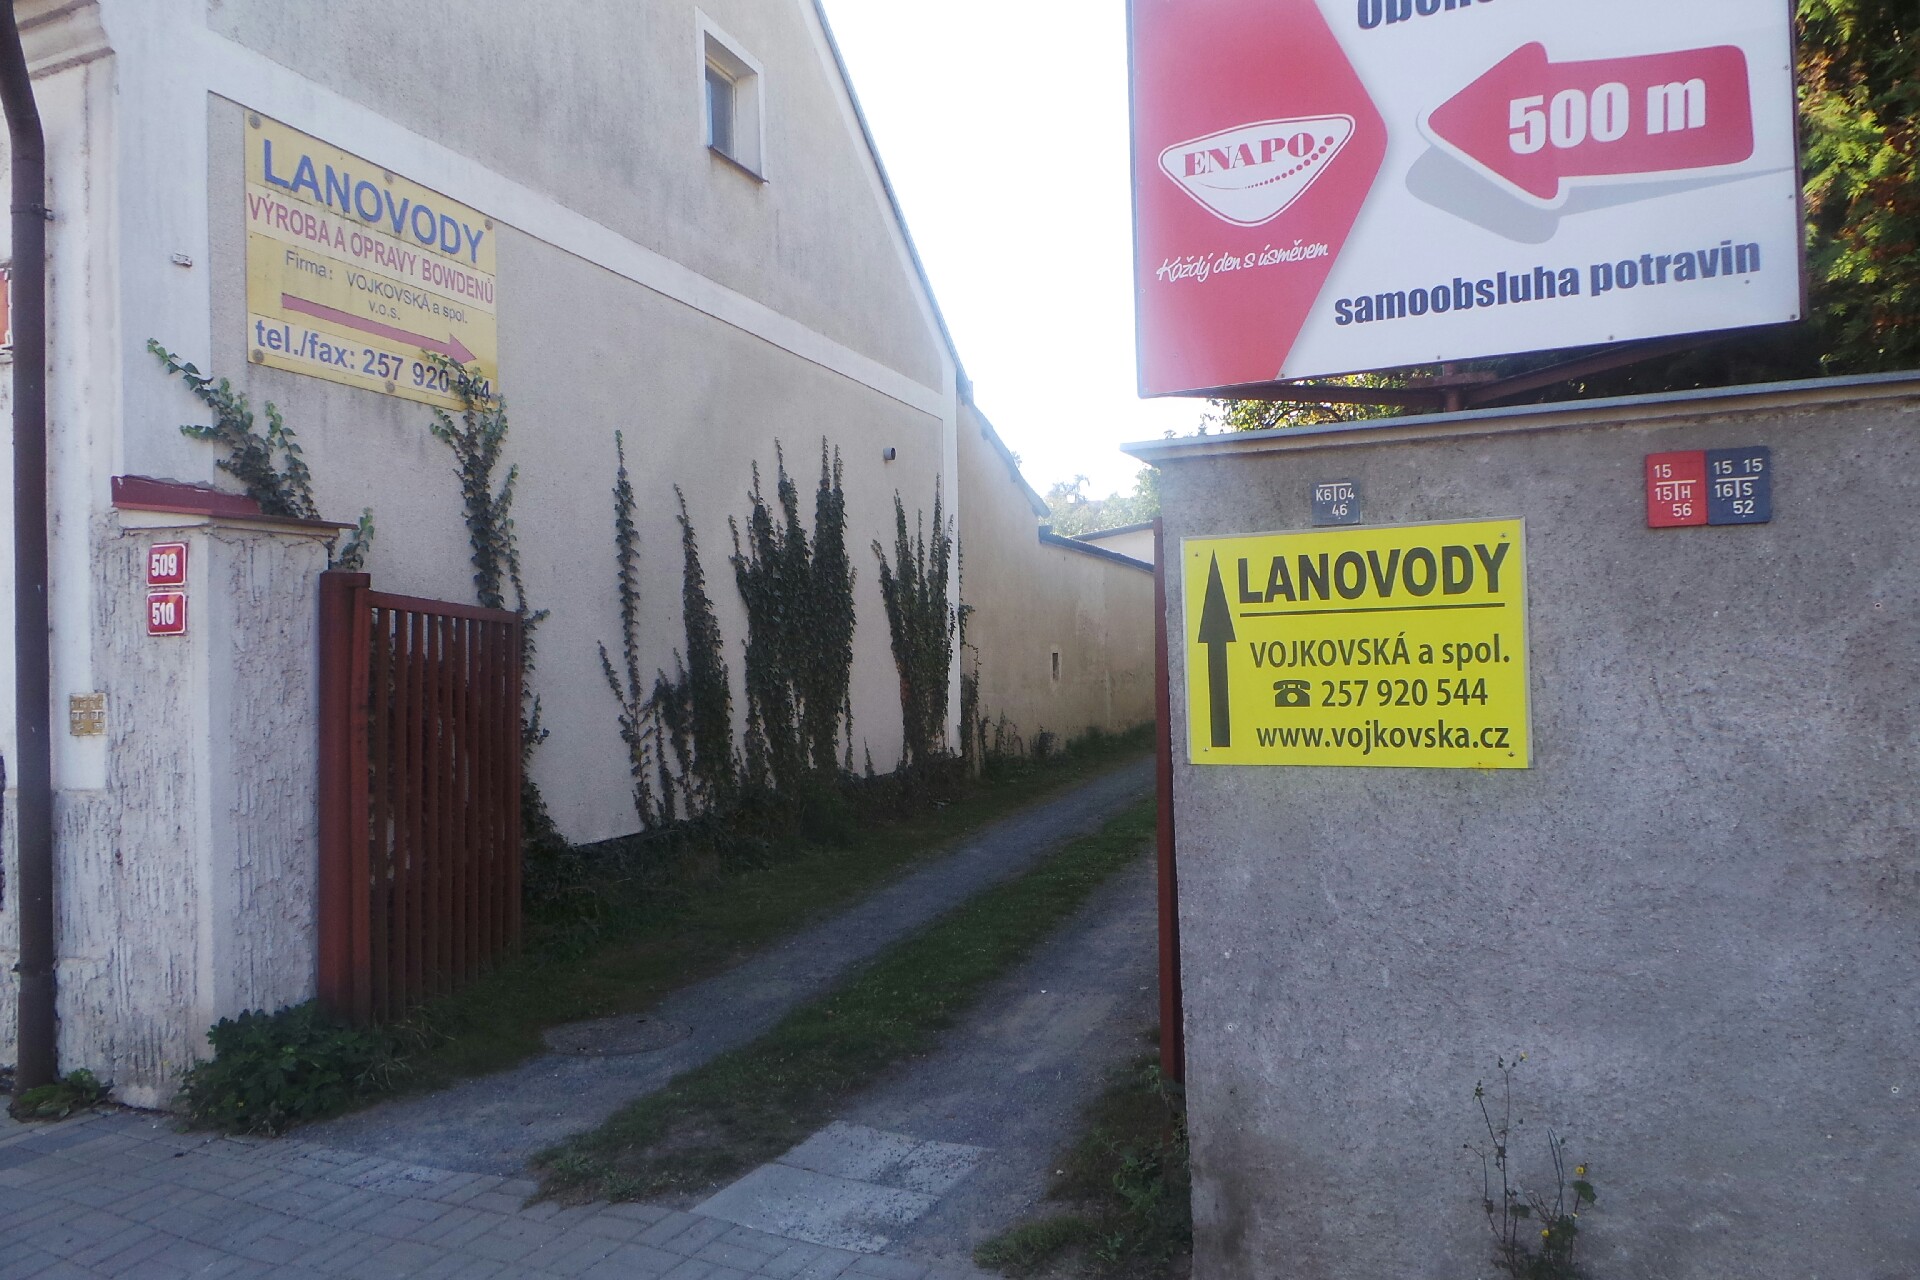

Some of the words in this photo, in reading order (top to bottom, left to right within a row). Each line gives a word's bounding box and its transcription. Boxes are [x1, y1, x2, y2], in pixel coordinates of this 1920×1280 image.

[1509, 82, 1629, 154] 500
[1647, 78, 1706, 135] m
[1183, 132, 1315, 178] ENAPO
[263, 138, 484, 264] LANOVODY
[248, 192, 331, 248] VÝROBA
[333, 226, 347, 252] A
[350, 231, 418, 277] OPRAVY
[421, 257, 494, 305] BOWDENŮ
[1156, 252, 1214, 282] Každý
[1213, 252, 1241, 274] den
[1243, 252, 1255, 269] s
[1258, 239, 1329, 267] úsměvem
[346, 269, 431, 313] VOJKOVSKÁ
[432, 303, 441, 315] a
[442, 306, 469, 324] spol.
[1334, 266, 1580, 326] samoobsluha
[1590, 239, 1762, 297] potravin
[255, 319, 355, 371] tel./fax:
[362, 348, 404, 381] 257
[412, 362, 450, 393] 920
[1654, 464, 1672, 479] 15
[1714, 461, 1733, 475] 15
[1744, 458, 1764, 473] 15
[1655, 486, 1673, 501] 15
[1681, 485, 1691, 499] H
[1715, 484, 1734, 498] 16
[1742, 482, 1753, 496] S
[1733, 500, 1755, 515] 52
[1331, 503, 1348, 516] 46
[1672, 503, 1693, 517] 56
[151, 553, 177, 577] 509
[1238, 542, 1511, 604] LANOVODY
[152, 602, 175, 626] 510
[1250, 631, 1411, 668] VOJKOVSKÁ
[1418, 643, 1434, 665] a
[1442, 633, 1510, 671] spol.
[1321, 679, 1369, 707] 257
[1377, 678, 1428, 707] 920
[1436, 677, 1489, 706] 544
[1256, 719, 1510, 756] www.vojkovska.cz
